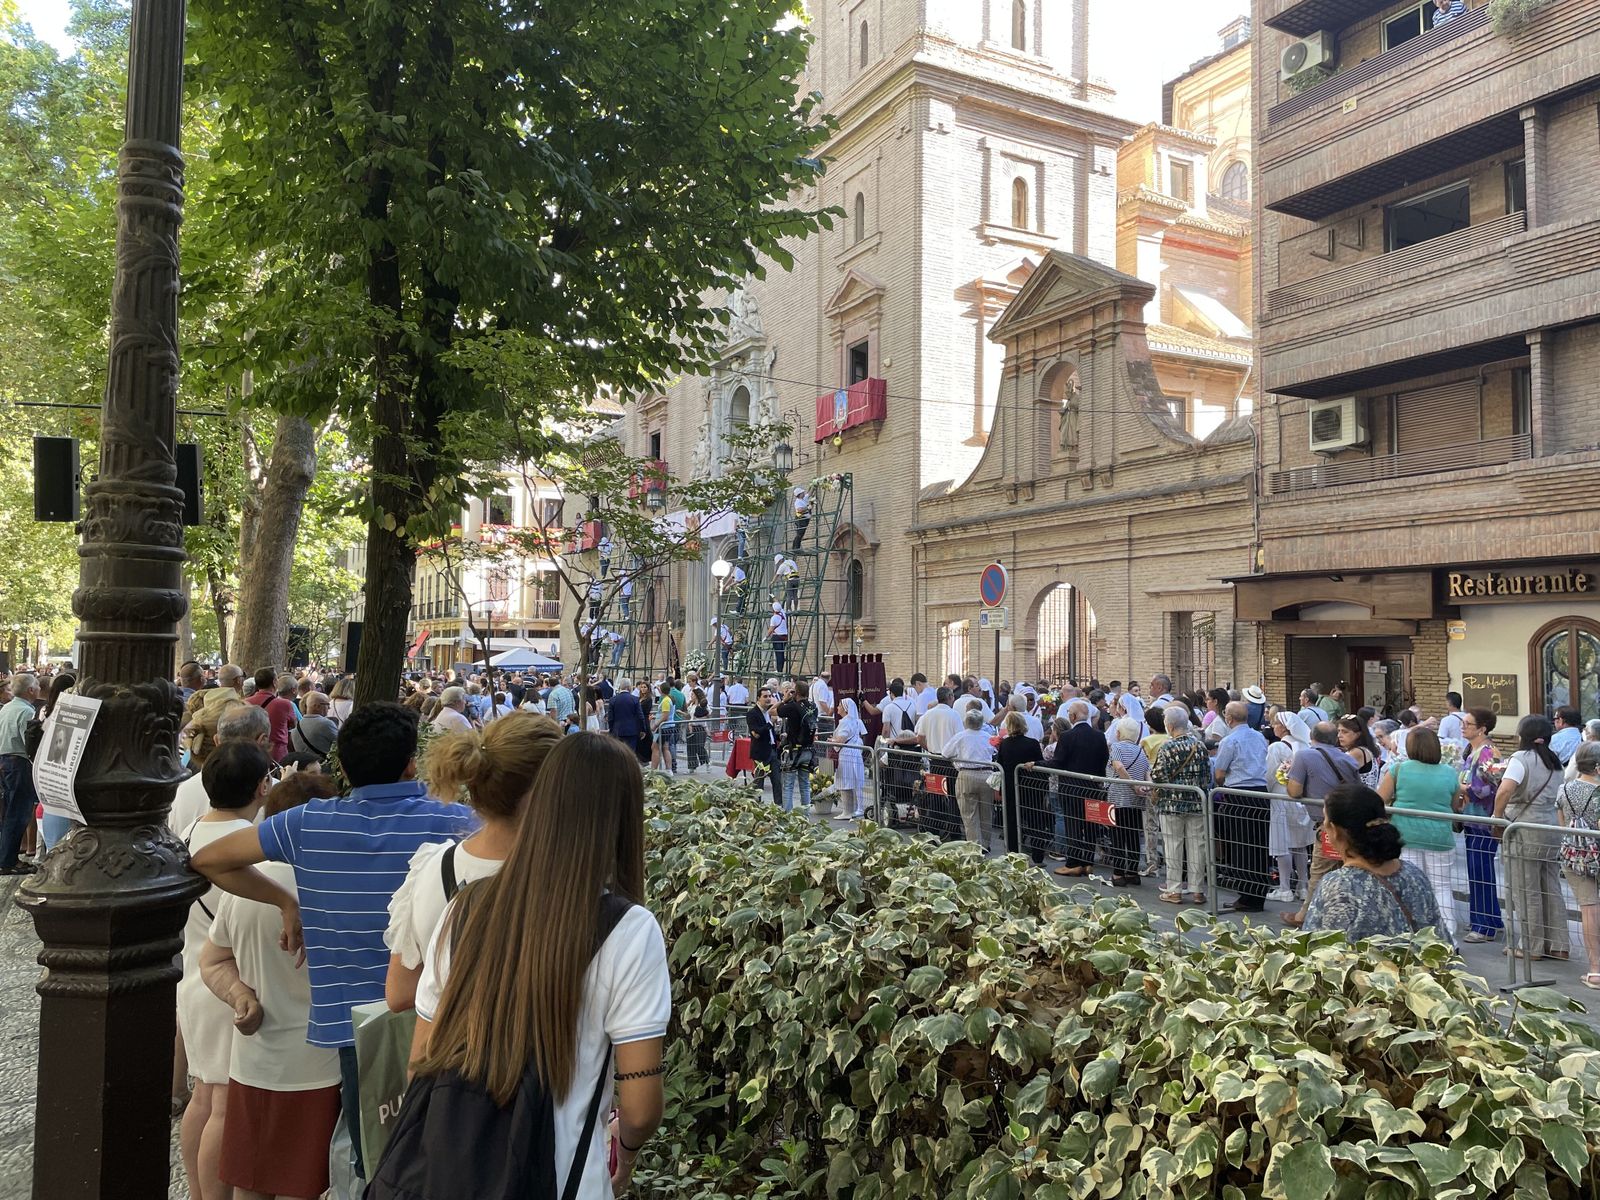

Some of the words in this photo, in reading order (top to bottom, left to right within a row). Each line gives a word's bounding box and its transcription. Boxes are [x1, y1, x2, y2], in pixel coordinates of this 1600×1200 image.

[1448, 571, 1587, 597] Restaurante
[69, 736, 82, 772] URGENTE
[378, 1093, 406, 1125] PU
